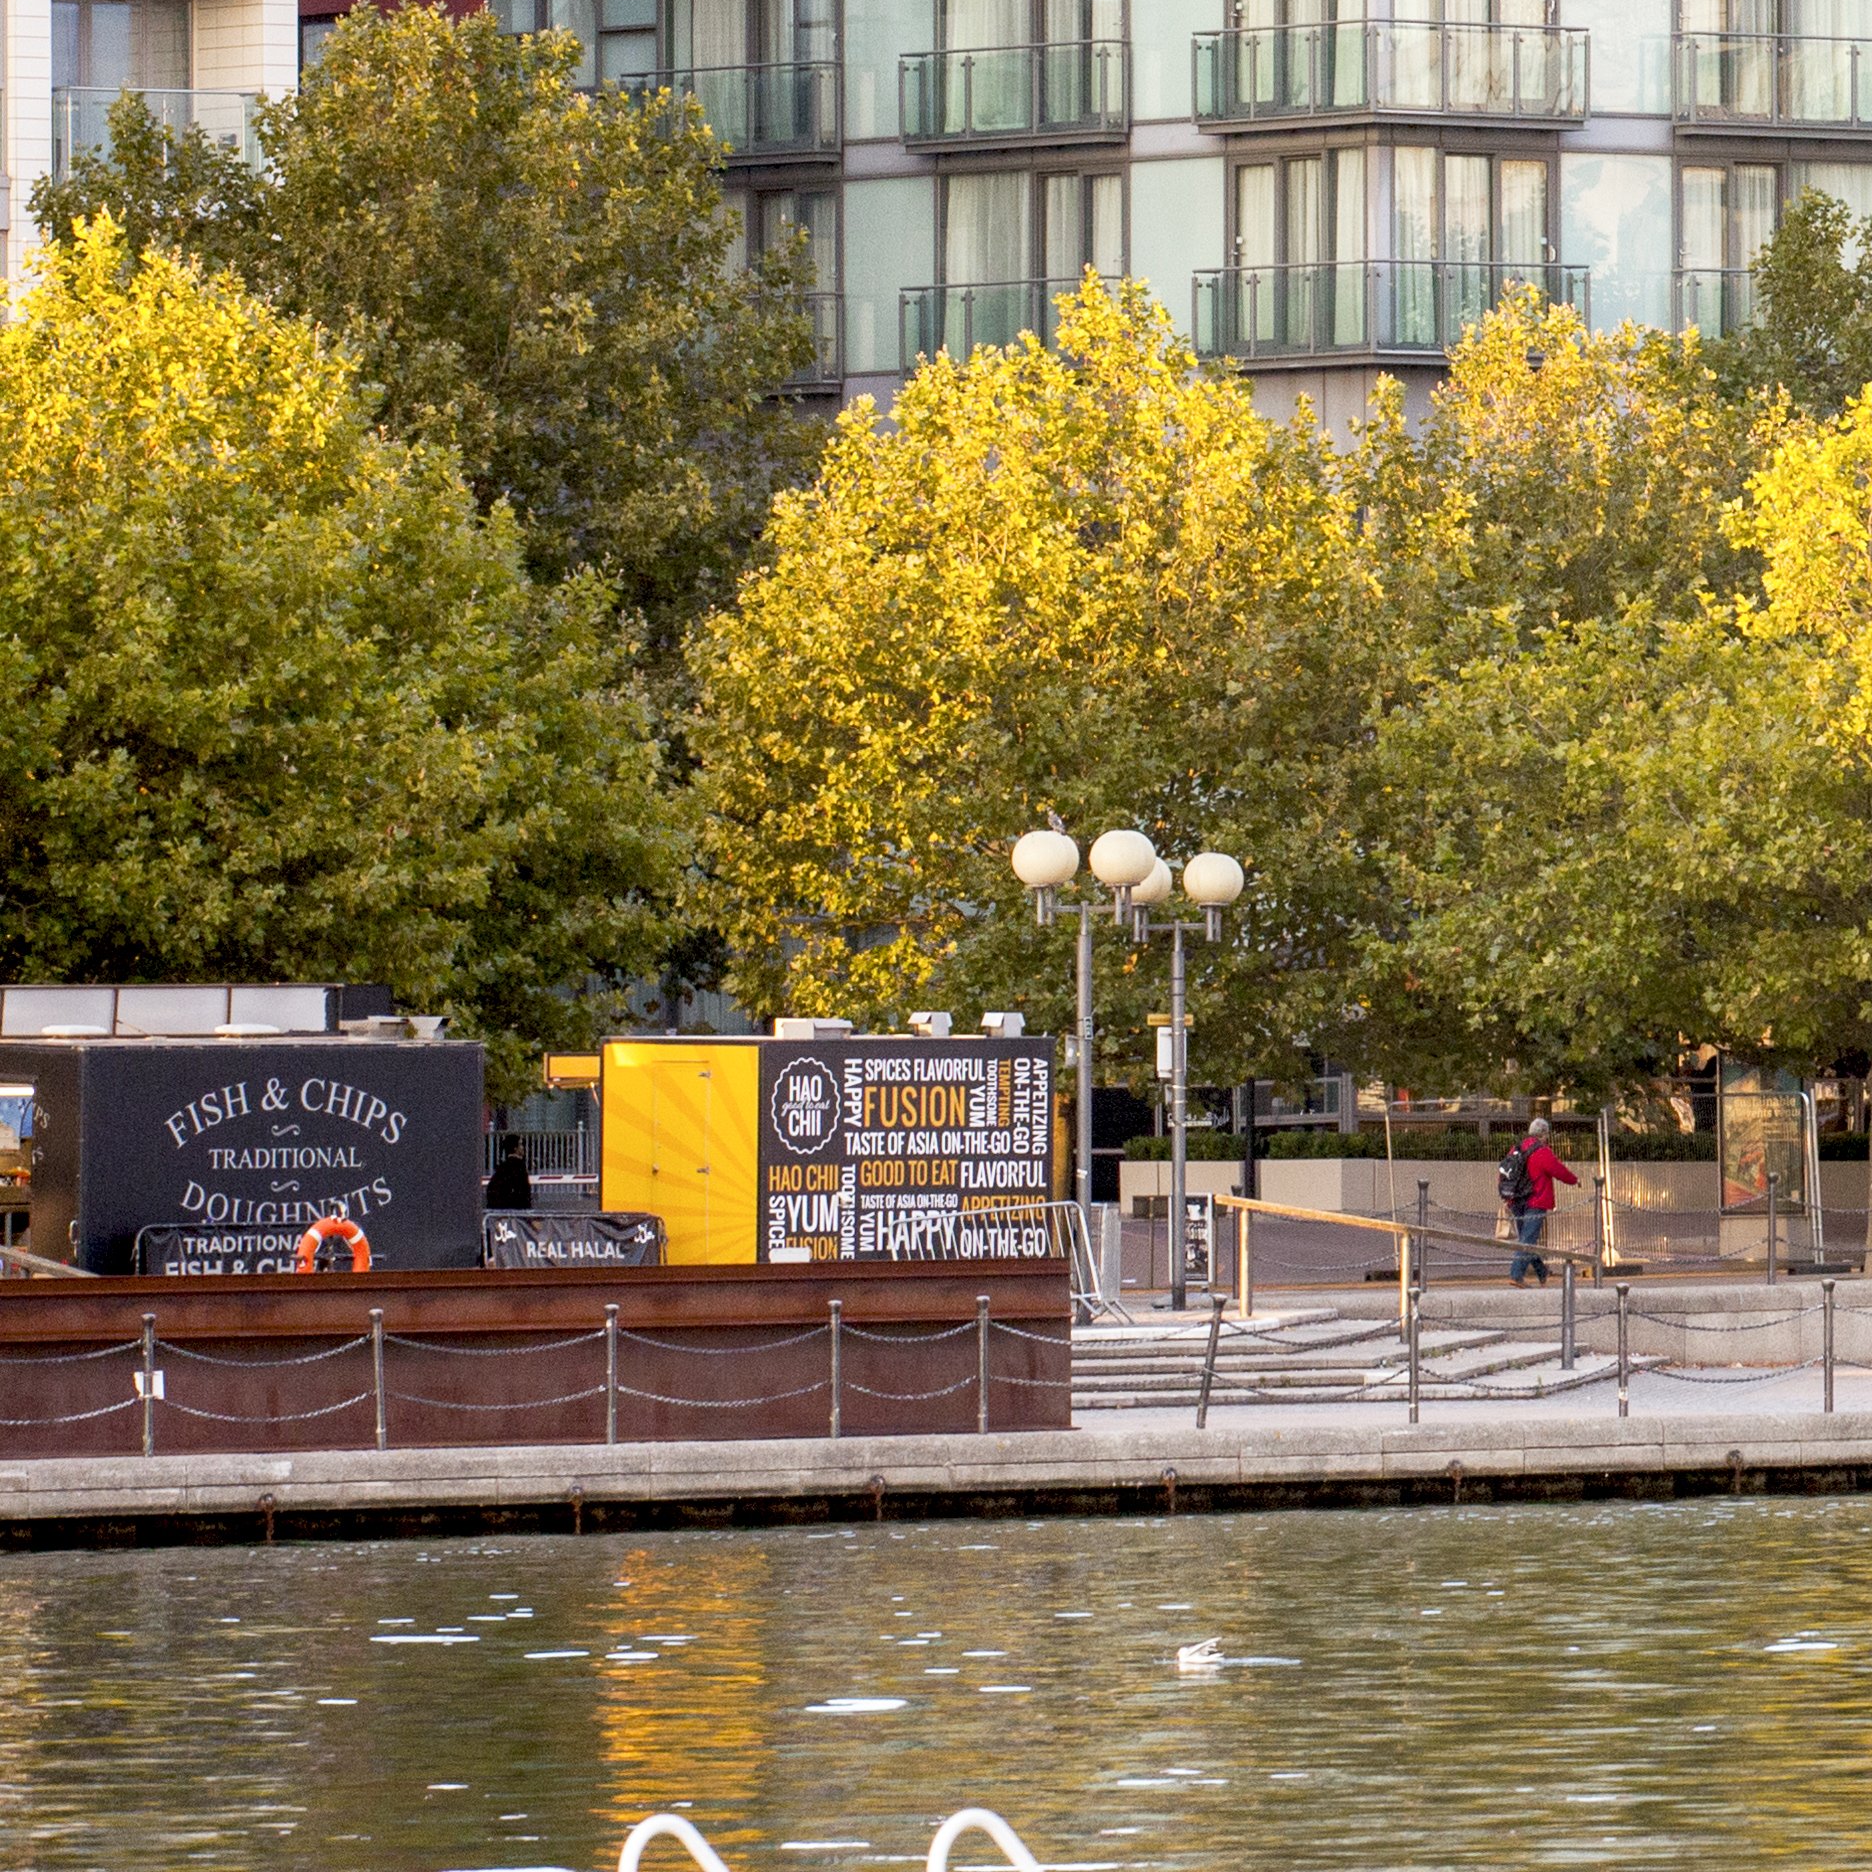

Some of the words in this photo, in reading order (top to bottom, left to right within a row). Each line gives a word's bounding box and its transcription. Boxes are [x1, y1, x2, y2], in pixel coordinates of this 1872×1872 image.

[865, 1058, 911, 1081] SPICES
[914, 1058, 986, 1082] FLAVORFUL
[789, 1075, 822, 1102] HAO
[843, 1058, 863, 1127] HAPPY
[998, 1059, 1011, 1127] TEMPTING
[164, 1082, 251, 1150] FISH
[261, 1077, 289, 1111] &
[300, 1078, 407, 1145] CHIPS
[864, 1085, 966, 1128] FUSION
[969, 1085, 986, 1128] YUM
[1013, 1057, 1031, 1154] ON-THE-GO
[1032, 1057, 1048, 1155] APPETIZING
[788, 1110, 821, 1137] CHII
[844, 1131, 885, 1155] TASTE
[888, 1131, 905, 1155] OF
[907, 1131, 939, 1155] ASIA
[941, 1130, 1011, 1155] ON-THE-GO
[208, 1146, 362, 1169] TRADITIONAL
[769, 1165, 802, 1192] HAO
[805, 1164, 839, 1191] CHII
[860, 1160, 905, 1186] GOOD
[908, 1160, 928, 1185] TO
[931, 1159, 959, 1185] EAT
[960, 1161, 1047, 1189] FLAVORFUL
[787, 1195, 839, 1233] YUM
[861, 1194, 884, 1209] TASTE
[885, 1194, 897, 1208] OF
[897, 1194, 916, 1208] ASIA
[183, 1234, 302, 1255] TRADITIONA
[859, 1211, 876, 1252] YUM
[877, 1209, 959, 1252] HAPPY
[526, 1241, 567, 1259] REAL
[571, 1241, 625, 1259] HALAL
